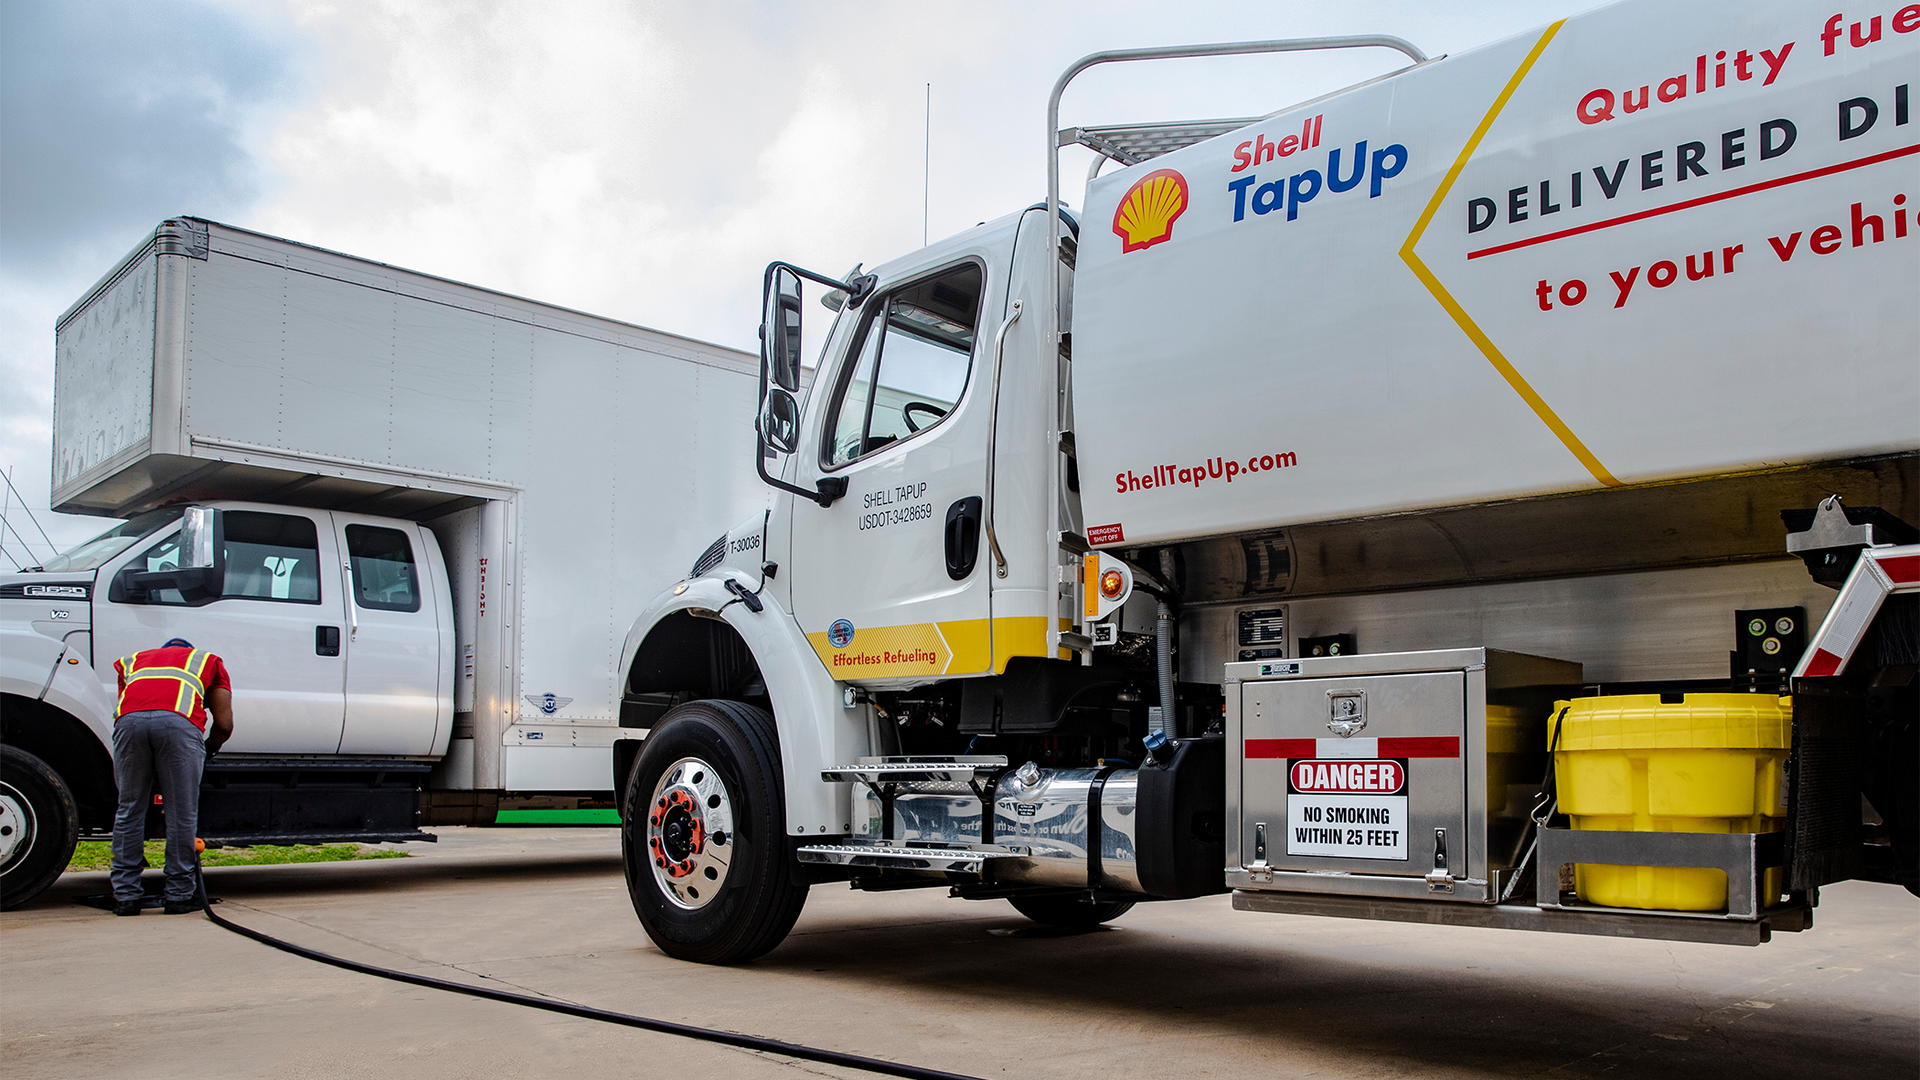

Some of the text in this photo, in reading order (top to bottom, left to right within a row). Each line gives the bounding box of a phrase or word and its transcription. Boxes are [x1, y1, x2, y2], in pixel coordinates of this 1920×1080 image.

[1576, 41, 1796, 125] Quality
[1230, 114, 1324, 173] Shell
[1467, 83, 1909, 234] DELIVERED DI
[1227, 139, 1408, 223] TapUp
[1535, 193, 1920, 312] to your vehi
[1115, 451, 1298, 494] ShellTapUp.com
[863, 482, 927, 509] SHELL TAPUP
[859, 503, 932, 531] USDOT-3428659
[730, 534, 761, 554] T-30036
[1089, 526, 1121, 536] EMERGENCY
[1093, 535, 1107, 543] SHUT
[50, 609, 69, 619] V10
[833, 648, 936, 667] Effortless Refueling
[1299, 763, 1395, 790] DANGER
[1303, 806, 1390, 824] NO SMOKING
[1295, 827, 1399, 847] WITHIN 25 FEET
